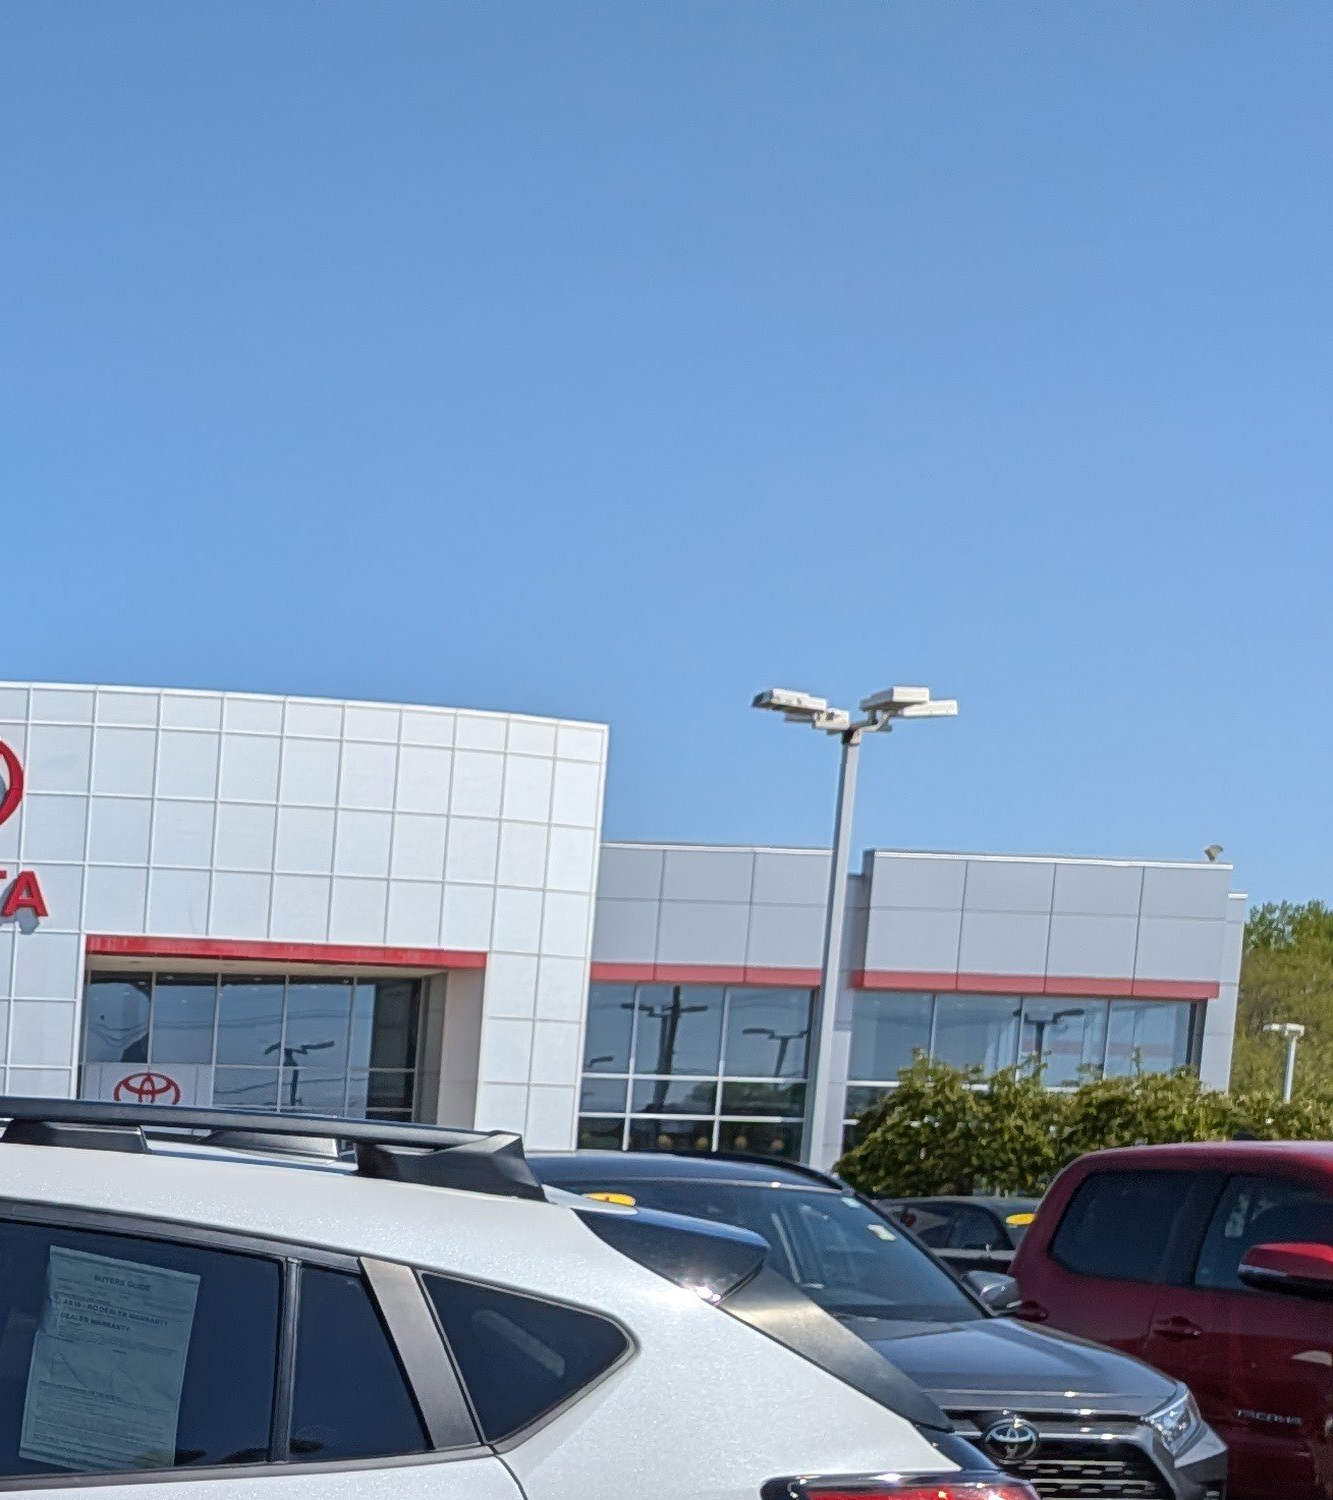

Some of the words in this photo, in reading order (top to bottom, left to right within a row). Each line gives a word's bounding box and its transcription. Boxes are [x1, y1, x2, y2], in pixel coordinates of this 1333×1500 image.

[94, 1275, 125, 1287] BUYERS
[127, 1281, 151, 1291] GUIDE
[99, 1306, 128, 1319] DEALER
